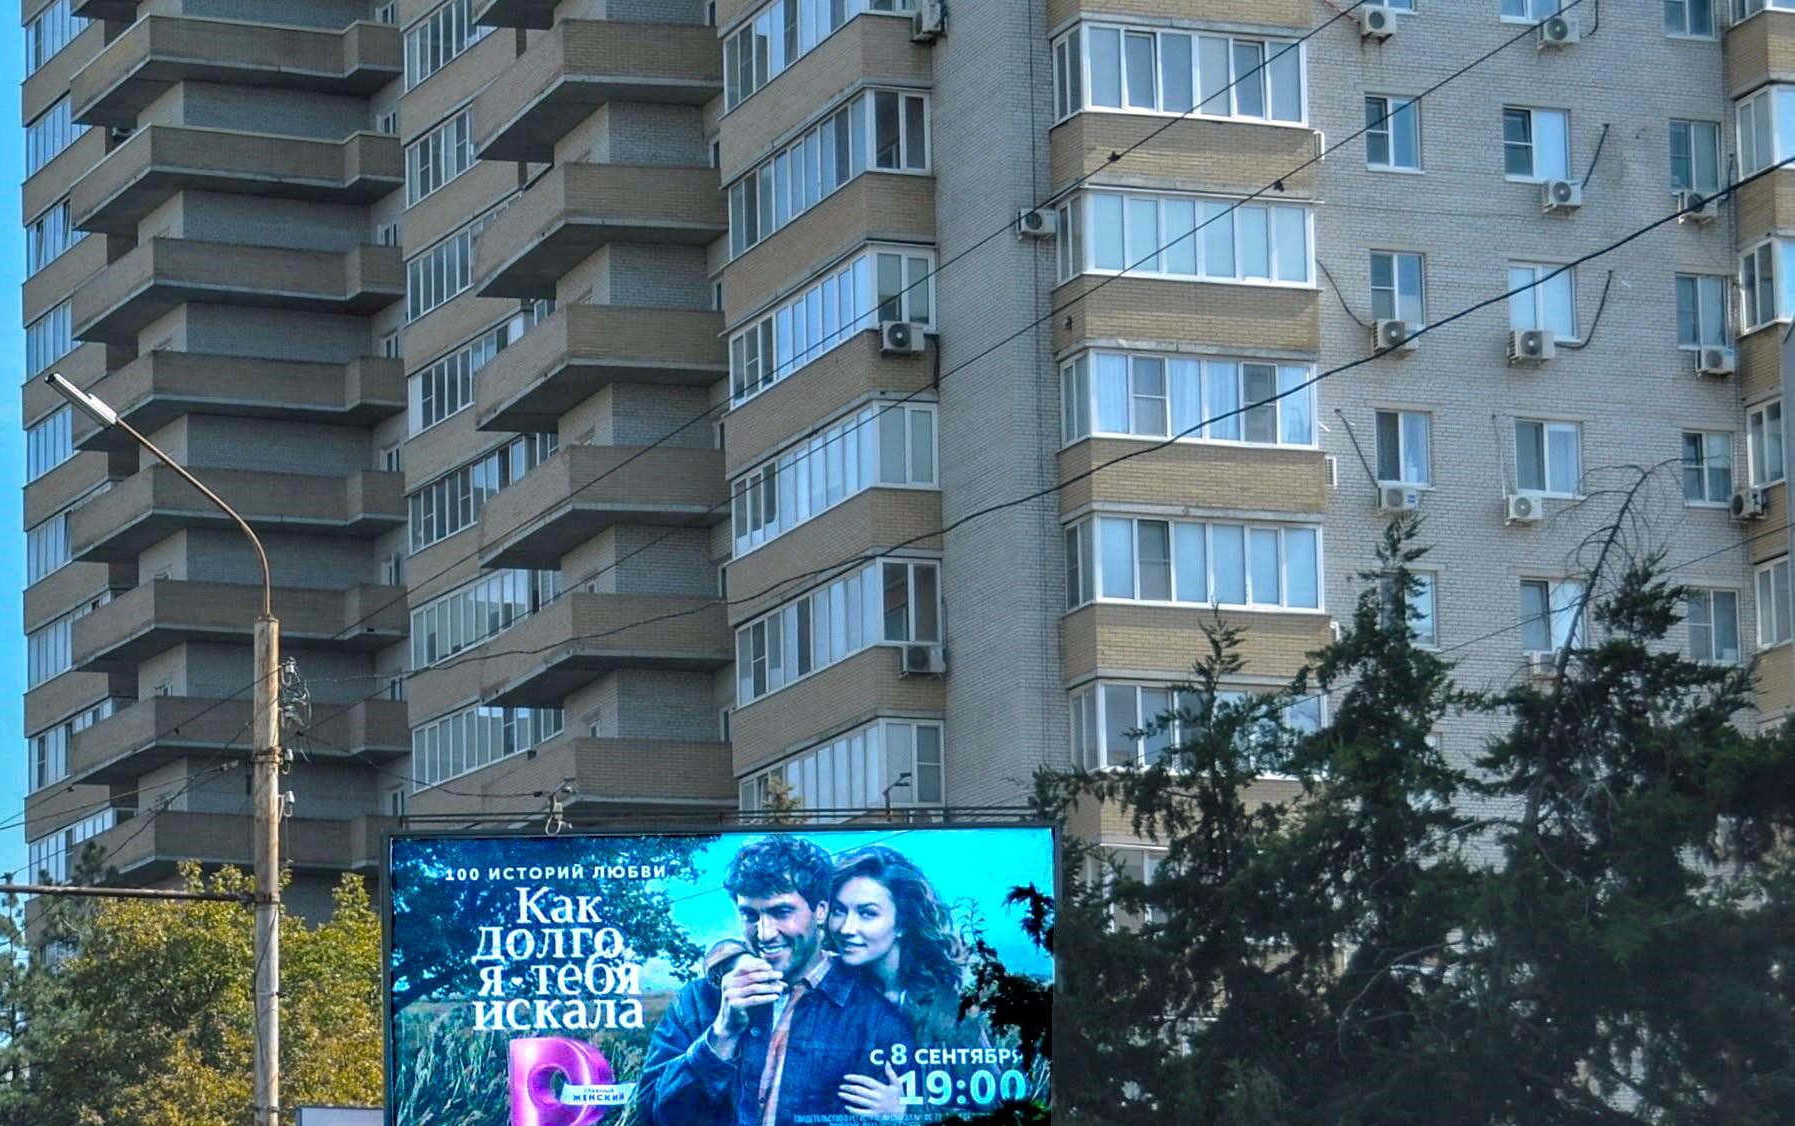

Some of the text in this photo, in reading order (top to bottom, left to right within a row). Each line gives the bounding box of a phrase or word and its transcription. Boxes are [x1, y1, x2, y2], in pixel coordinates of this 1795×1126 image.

[445, 863, 666, 881] 100 ИСТОРИЙ ЛЮБВИ
[515, 886, 603, 924] Как
[471, 926, 624, 965] долго
[477, 951, 643, 997] я тебя
[471, 998, 646, 1031] искала
[891, 1043, 907, 1065] 8
[573, 1092, 625, 1102] ЖЕНСКИЙ
[898, 1069, 1027, 1106] 19:00
